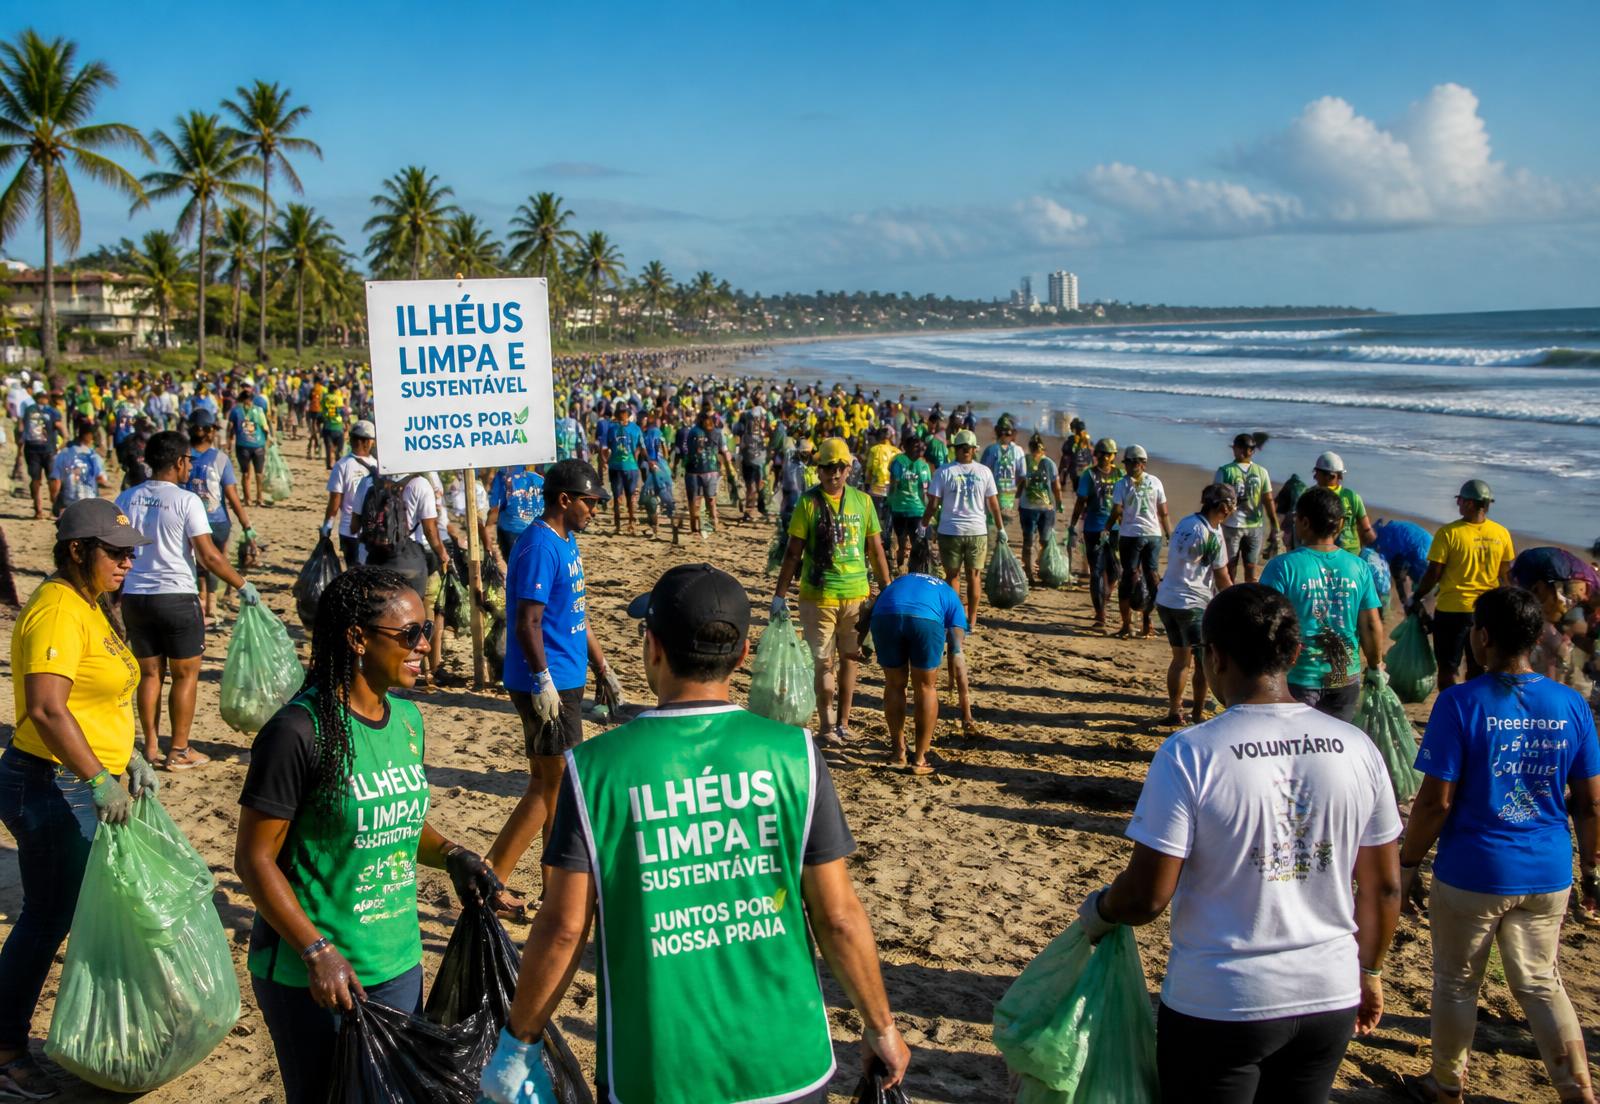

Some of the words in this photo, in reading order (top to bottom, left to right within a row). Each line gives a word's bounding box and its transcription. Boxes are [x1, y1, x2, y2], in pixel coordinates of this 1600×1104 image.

[396, 293, 524, 337] ILHÉUS
[399, 343, 500, 375] LIMPA
[508, 342, 526, 370] E
[401, 375, 528, 399] SUSTENTÁVEL
[404, 413, 473, 432] JUNTOS
[478, 411, 513, 427] POR
[404, 434, 466, 451] NOSSA
[470, 430, 520, 447] PRAIA
[1230, 733, 1344, 760] VOLUNTÁRIO
[628, 765, 776, 823] ILHÉUS
[635, 818, 751, 865] LIMPA
[757, 814, 779, 848] E
[641, 854, 782, 892] SUSTENTÁVEL
[650, 902, 730, 933] JUNTOS
[735, 896, 777, 918] POR
[651, 929, 721, 957] NOSSA
[725, 916, 786, 945] PRAIA
